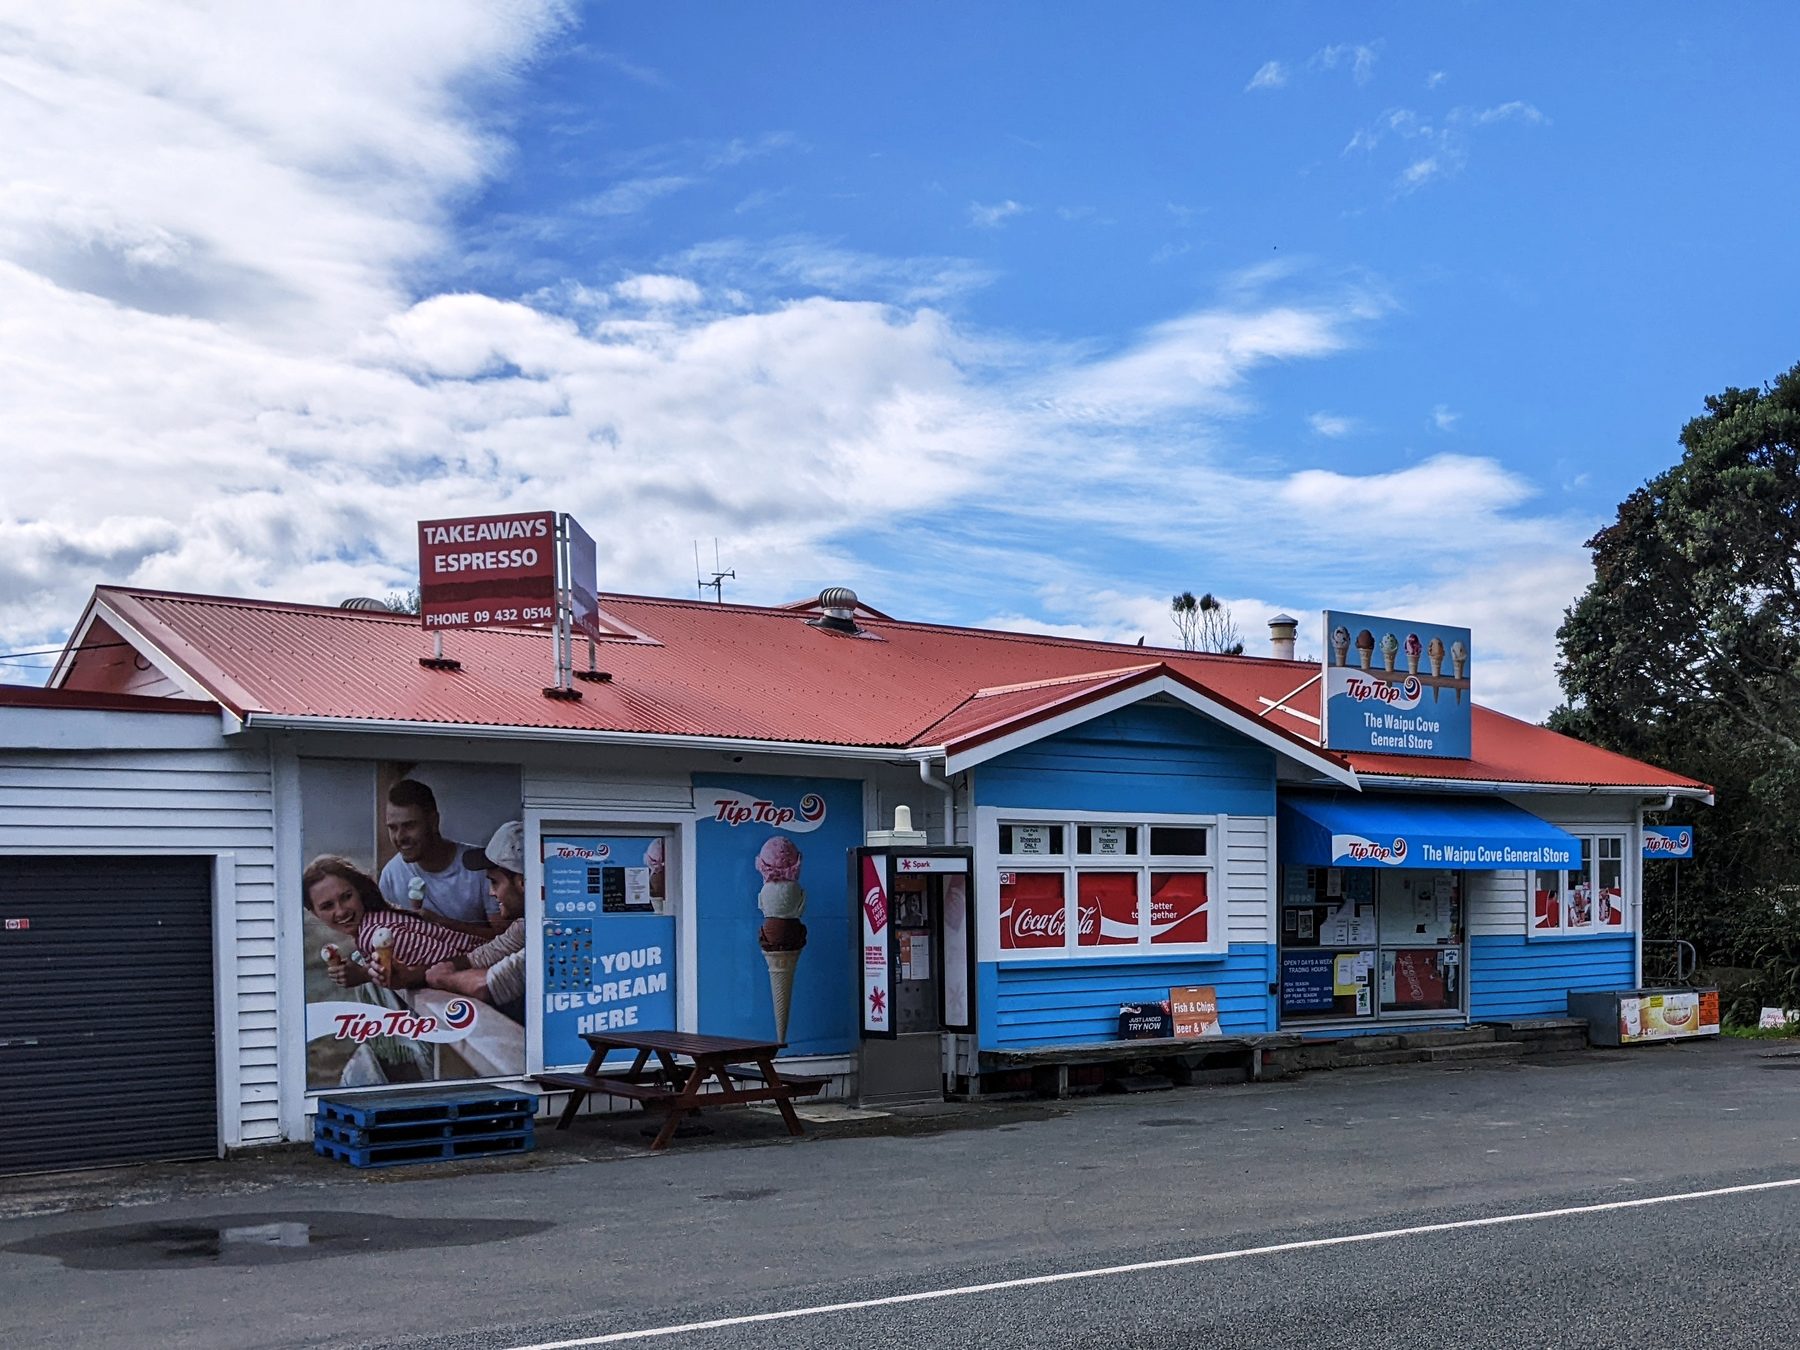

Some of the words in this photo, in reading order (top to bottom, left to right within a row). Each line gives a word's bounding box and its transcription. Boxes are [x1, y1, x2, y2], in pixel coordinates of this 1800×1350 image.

[424, 518, 548, 545] TAKEAWAYS
[434, 548, 538, 573] ESPRESSO
[426, 612, 469, 626] PHONE
[474, 611, 490, 623] 09
[494, 609, 518, 621] 432
[522, 607, 552, 620] 0514
[1346, 678, 1371, 701] Tip
[1372, 680, 1400, 704] Top
[1364, 712, 1383, 728] The
[1384, 713, 1415, 733] Waipu
[1416, 716, 1440, 733] Cove
[1371, 731, 1407, 748] General
[1408, 734, 1433, 750] Store
[714, 800, 752, 825] Tip
[752, 801, 795, 826] Top
[557, 847, 574, 858] Tip
[574, 847, 594, 858] Top
[1348, 843, 1368, 859] Tip
[1368, 843, 1390, 860] Top
[1646, 837, 1660, 851] Tip
[1660, 837, 1677, 851] Top
[1422, 844, 1442, 861] The
[1443, 845, 1476, 864] Waipu
[1477, 846, 1503, 862] Cove
[1503, 846, 1542, 863] General
[1543, 847, 1570, 863] Store
[912, 860, 931, 869] Spark
[600, 946, 662, 974] YOUR
[546, 993, 584, 1014] ICE
[587, 972, 667, 1005] CREAM
[1173, 1002, 1188, 1013] Fish
[1189, 1001, 1195, 1012] &
[1196, 1001, 1215, 1014] Chips
[334, 1012, 382, 1042] Tip
[383, 1011, 437, 1039] Top
[577, 1005, 639, 1035] HERE
[871, 1015, 883, 1023] Spark
[1128, 1023, 1142, 1031] TRY
[1143, 1022, 1161, 1030] NOW
[1176, 1024, 1192, 1034] Beer
[1193, 1022, 1199, 1033] &
